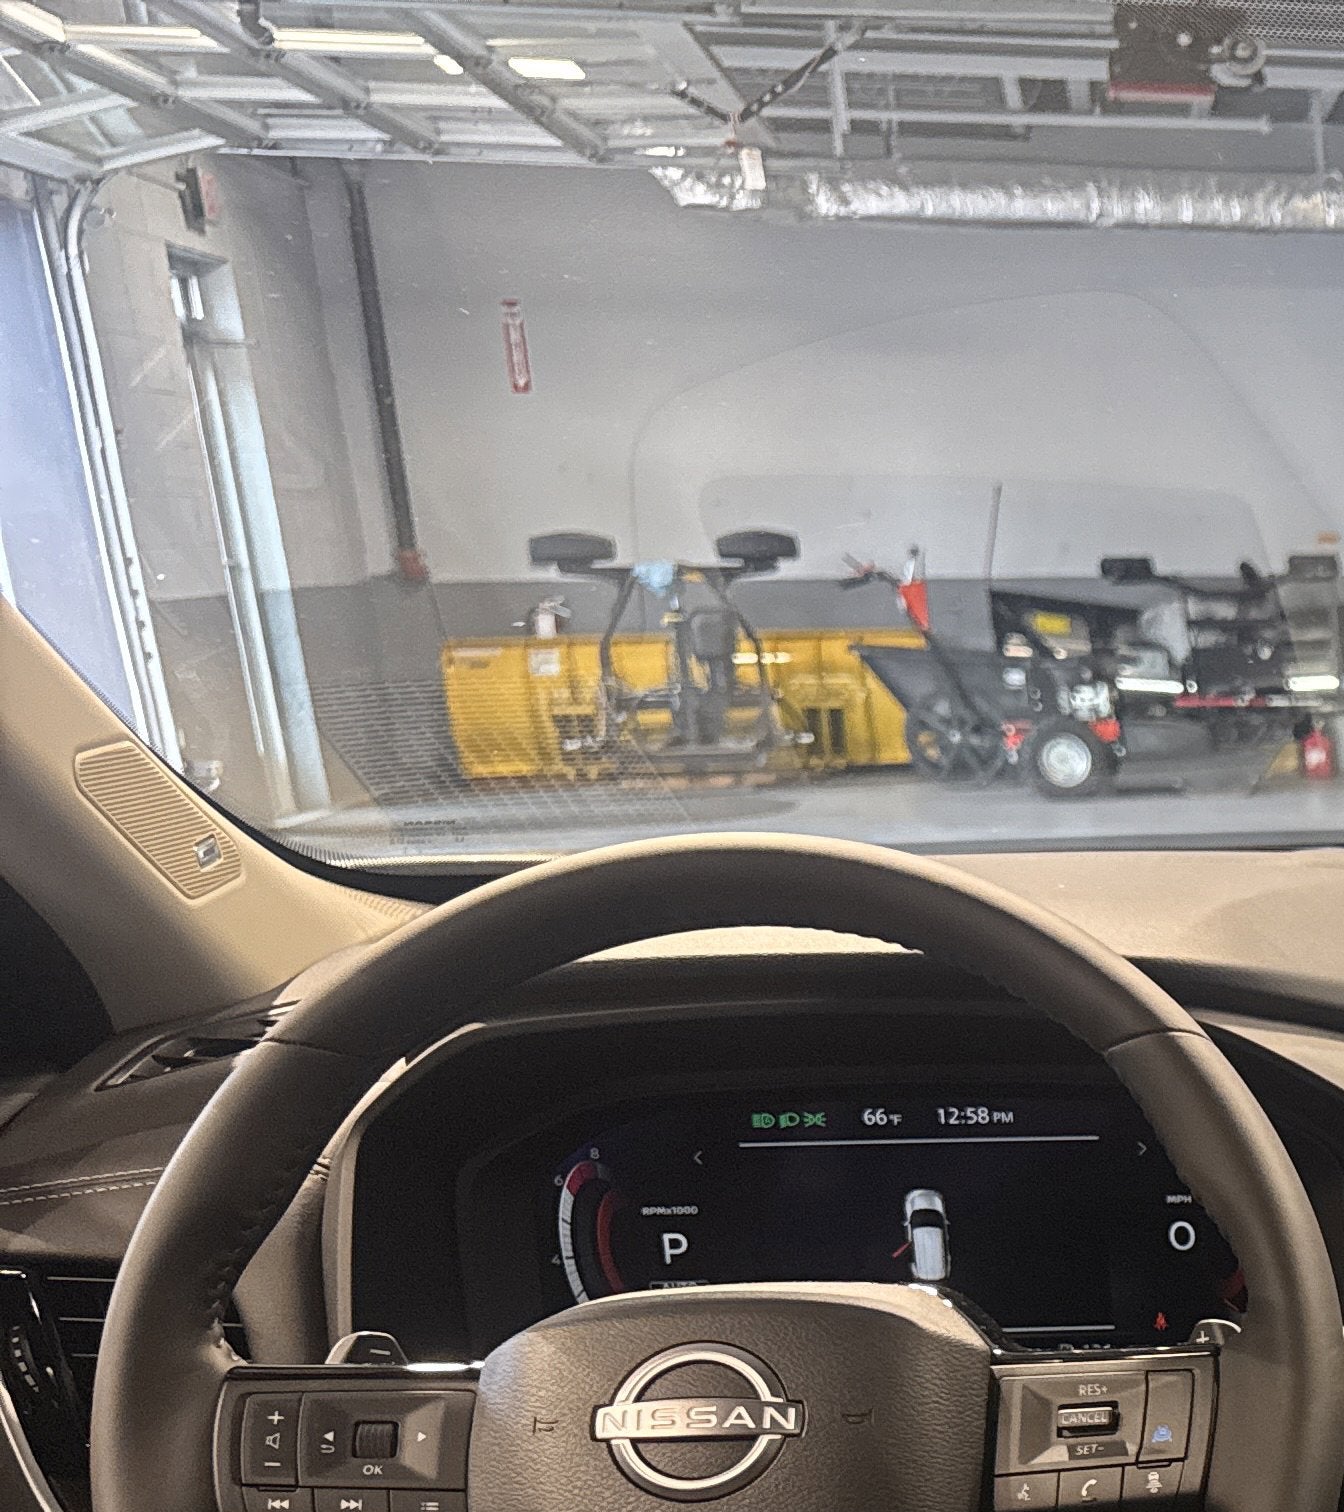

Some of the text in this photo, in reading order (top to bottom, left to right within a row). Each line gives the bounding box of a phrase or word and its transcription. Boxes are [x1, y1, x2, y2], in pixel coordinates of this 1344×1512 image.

[936, 1107, 990, 1126] 12:58
[992, 1111, 1015, 1125] PM
[554, 1175, 564, 1187] 6
[1166, 1194, 1192, 1204] MPH
[662, 1232, 689, 1265] P
[601, 1405, 797, 1432] NISSAN
[1060, 1411, 1109, 1425] CANCEL
[362, 1464, 384, 1476] OK
